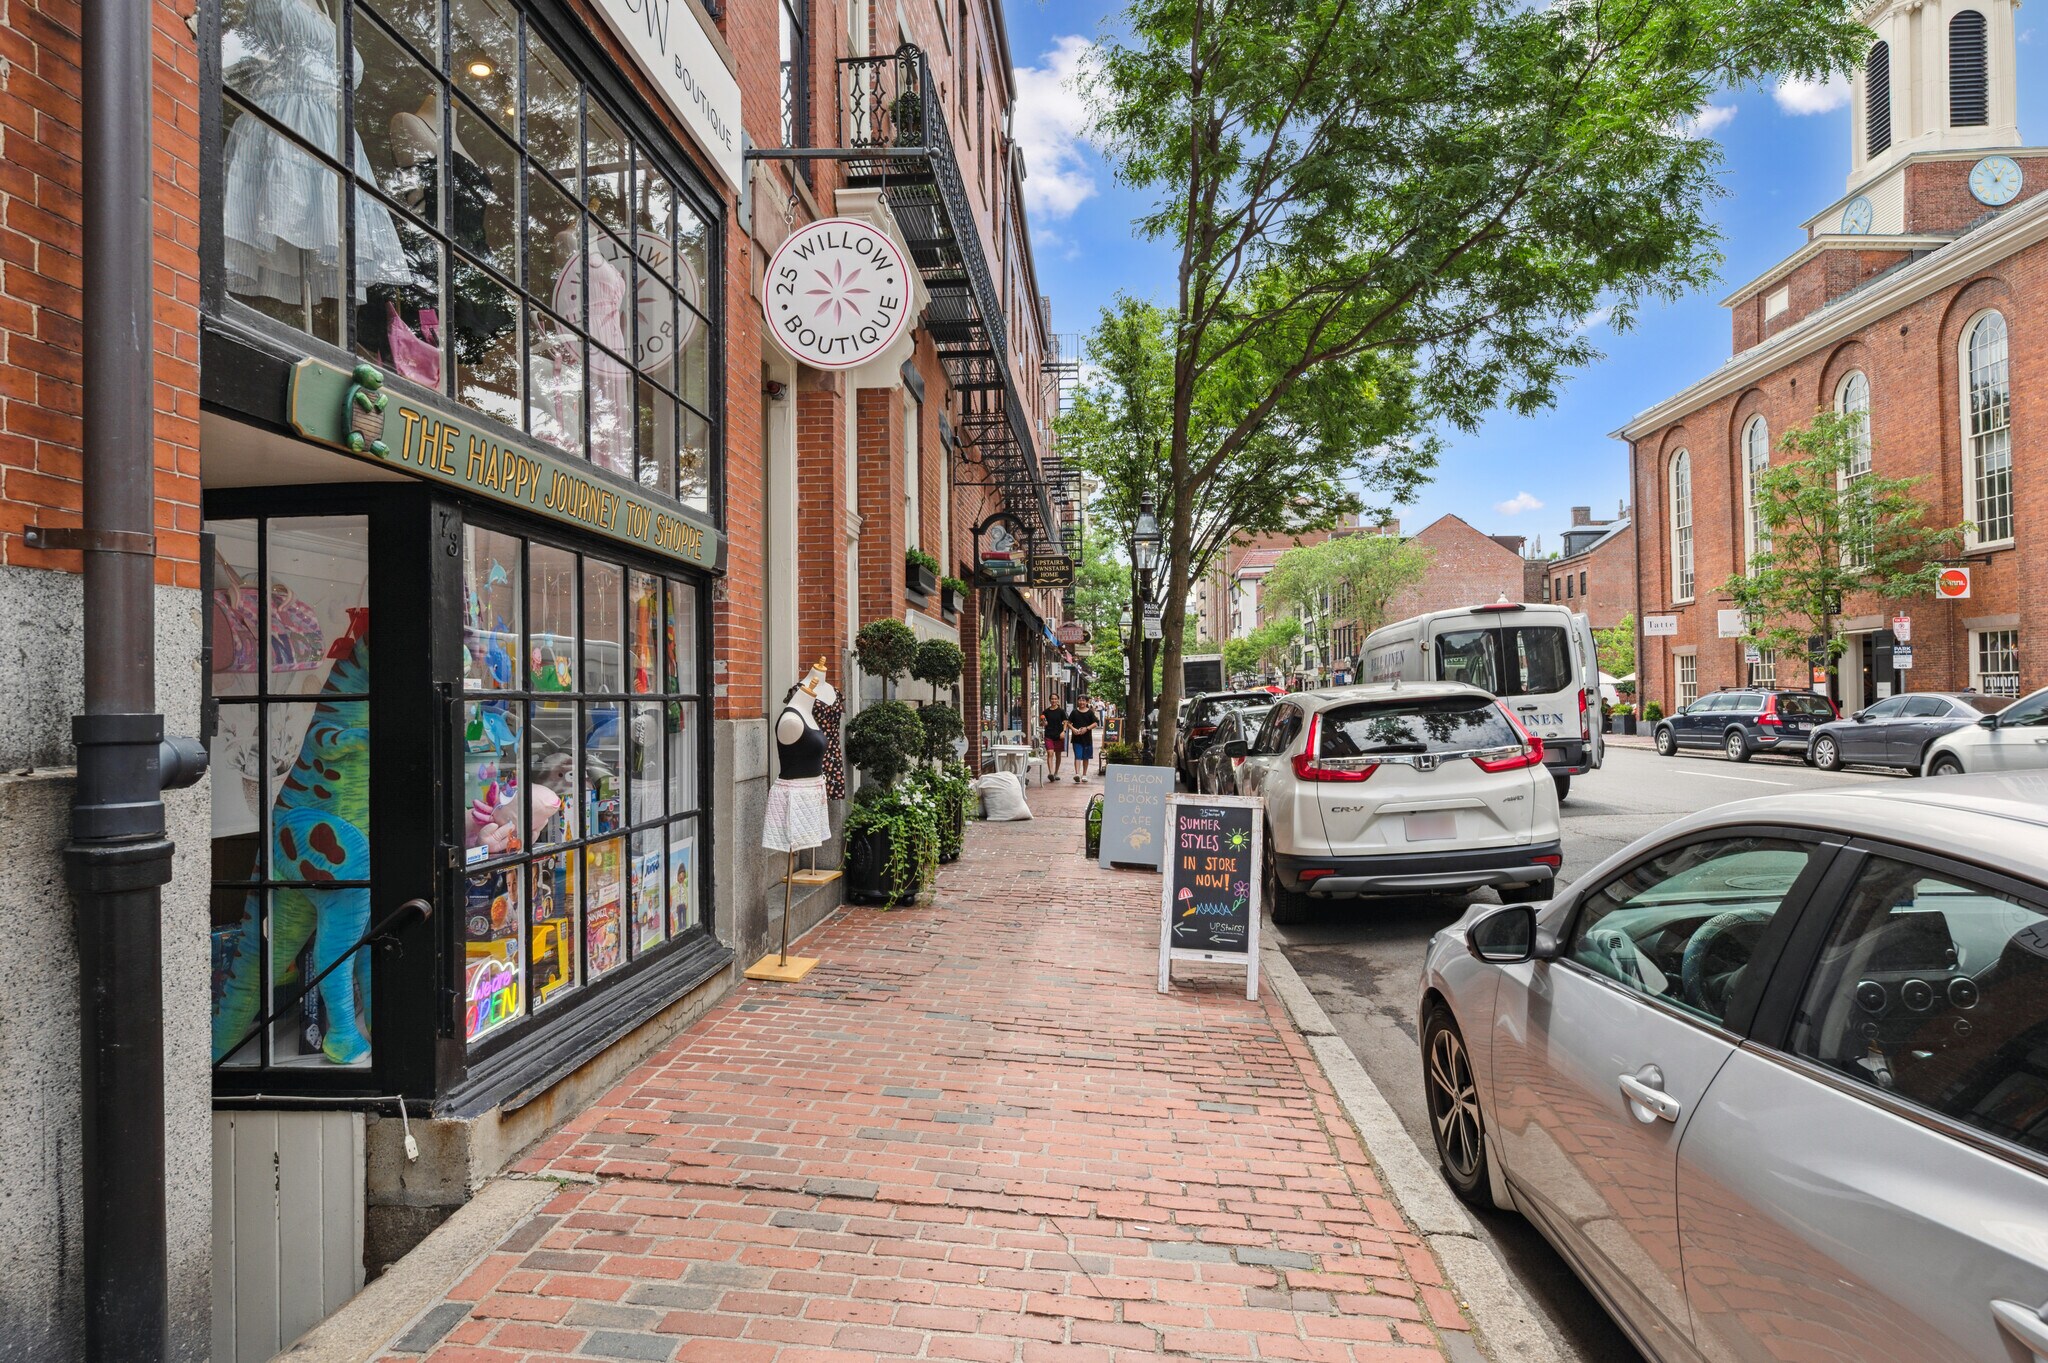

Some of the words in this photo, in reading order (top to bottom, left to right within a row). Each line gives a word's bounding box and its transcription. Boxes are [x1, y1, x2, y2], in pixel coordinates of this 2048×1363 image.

[674, 53, 732, 152] BOUTIQUE
[776, 266, 798, 296] 25
[793, 231, 893, 272] WILLOW
[784, 295, 898, 355] BOUTIQUE
[399, 406, 460, 476] THE
[466, 434, 542, 504] HAPPY
[544, 469, 620, 531] JOURNEY
[626, 500, 652, 542] TOY
[654, 513, 704, 561] SHOPPE
[438, 511, 459, 557] 73
[1648, 620, 1675, 628] Tatte
[1384, 650, 1405, 666] LINEN
[1985, 675, 2019, 687] minni
[1520, 713, 1563, 726] INEN
[1116, 773, 1163, 784] BEACON
[1127, 784, 1150, 794] HILL
[1118, 793, 1159, 805] BOOKS
[1331, 805, 1364, 813] CR-V
[1121, 815, 1152, 826] CAFE
[1180, 816, 1221, 831] SUMMER
[1181, 832, 1219, 852] STYLES
[1183, 856, 1196, 870] IN
[1204, 857, 1237, 872] STORE
[1195, 873, 1229, 891] NOW!
[474, 981, 493, 1001] we
[492, 970, 512, 993] are
[466, 982, 517, 1038] OPEN
